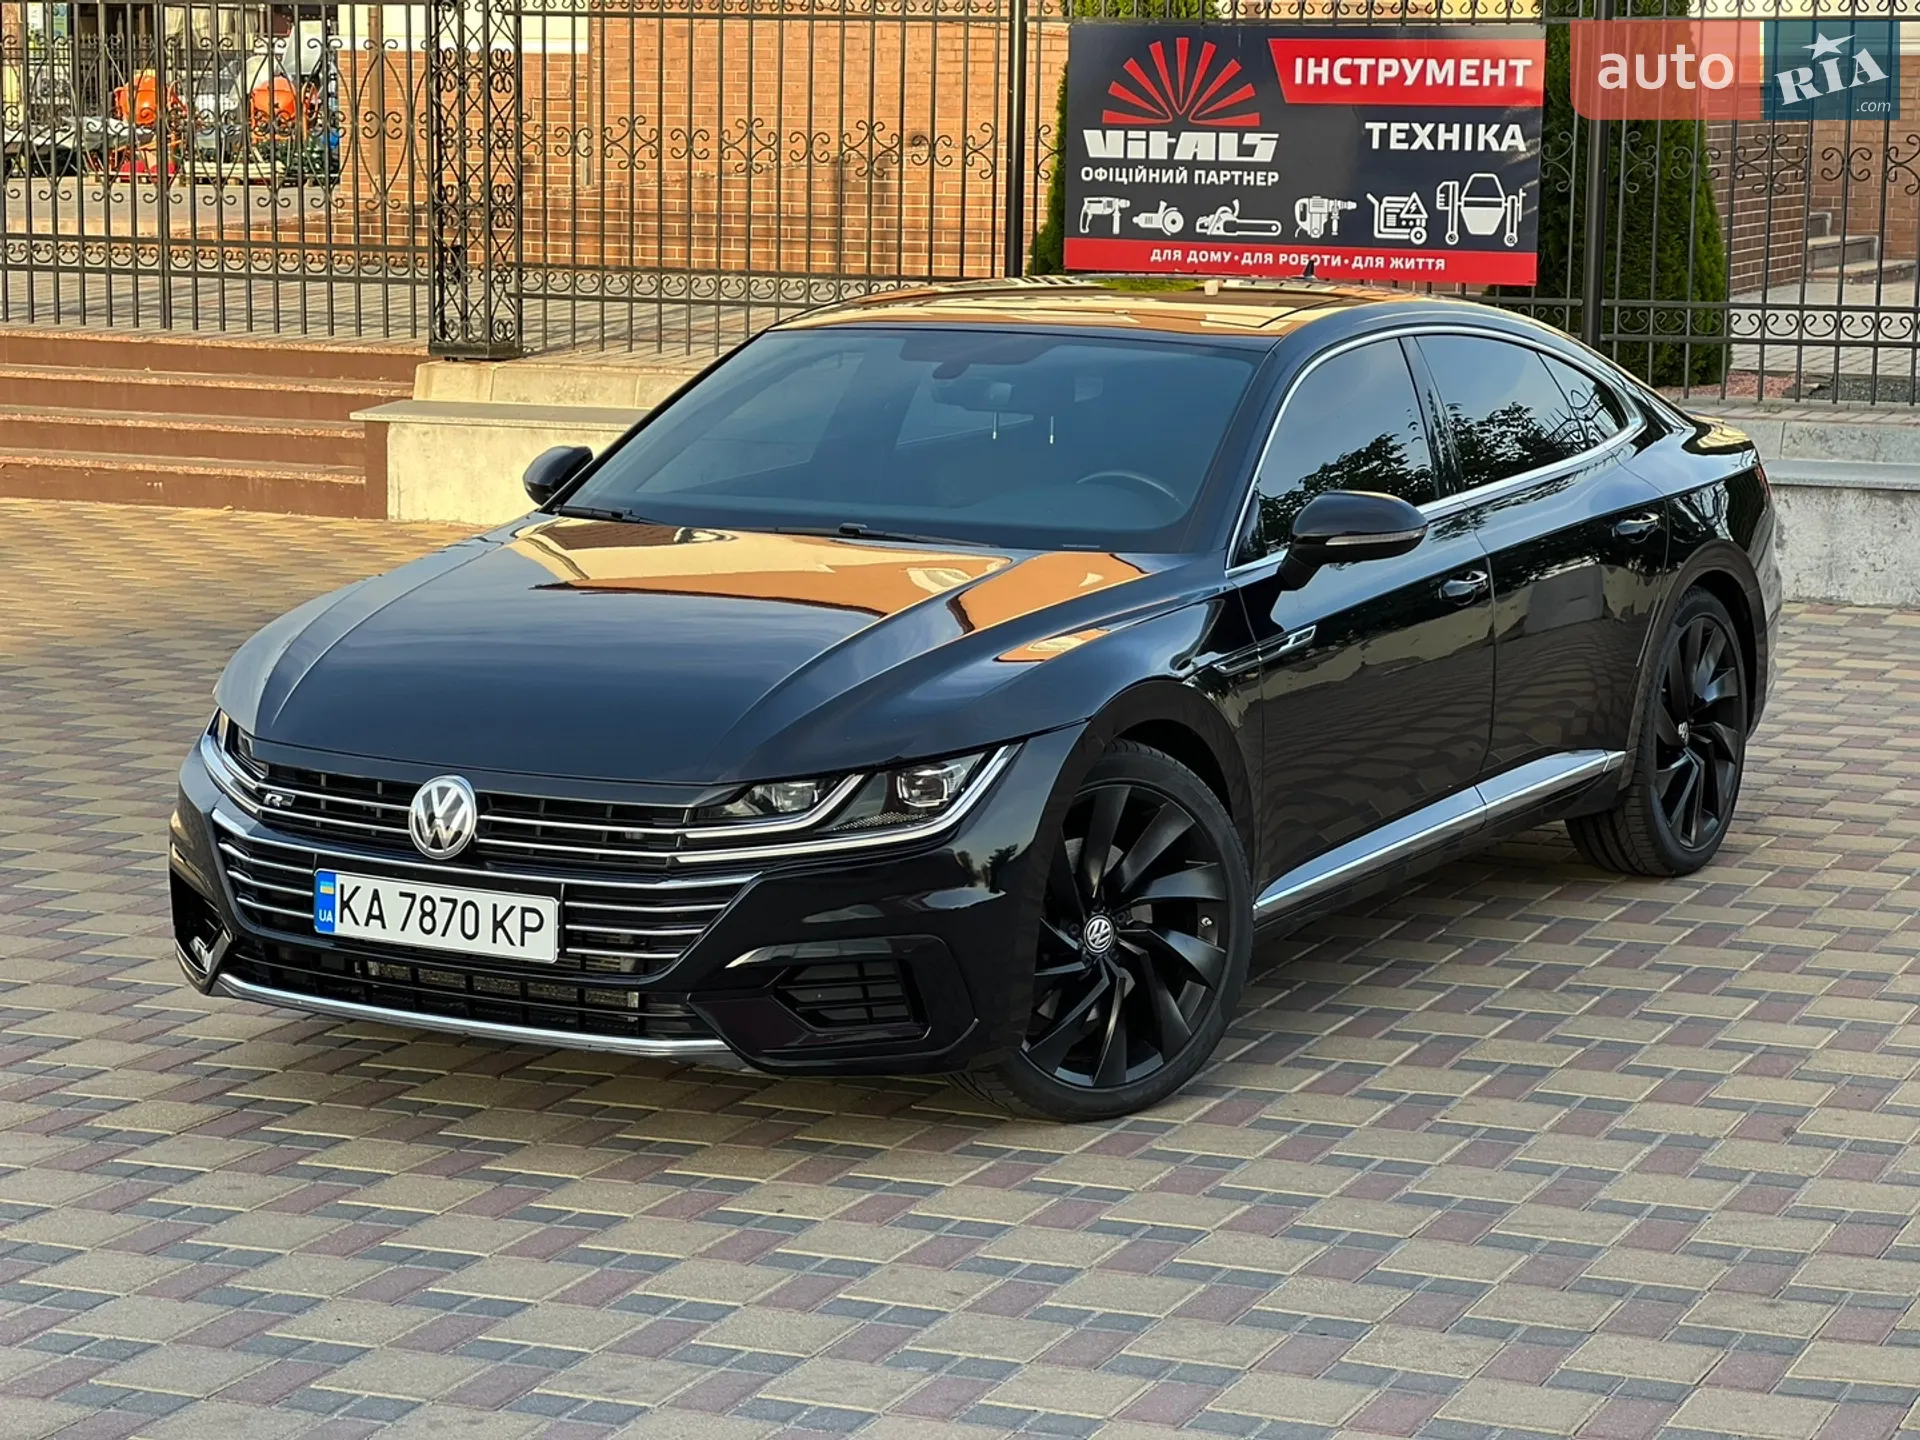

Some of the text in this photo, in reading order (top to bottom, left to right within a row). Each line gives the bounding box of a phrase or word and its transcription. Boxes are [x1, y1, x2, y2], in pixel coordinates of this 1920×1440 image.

[1294, 57, 1532, 88] ІНСТРУМЕНТ
[1365, 121, 1526, 152] ТЕХНІКА
[1081, 166, 1279, 187] ОФІЦІЙНИЙ ПАРТНЕР
[1150, 249, 1446, 271] ДЛЯ ДОМУ ДЛЯ РОБОТИ ДЛЯ ЖИТТЯ
[319, 909, 334, 923] UA
[339, 884, 544, 947] KA 7870 KP
